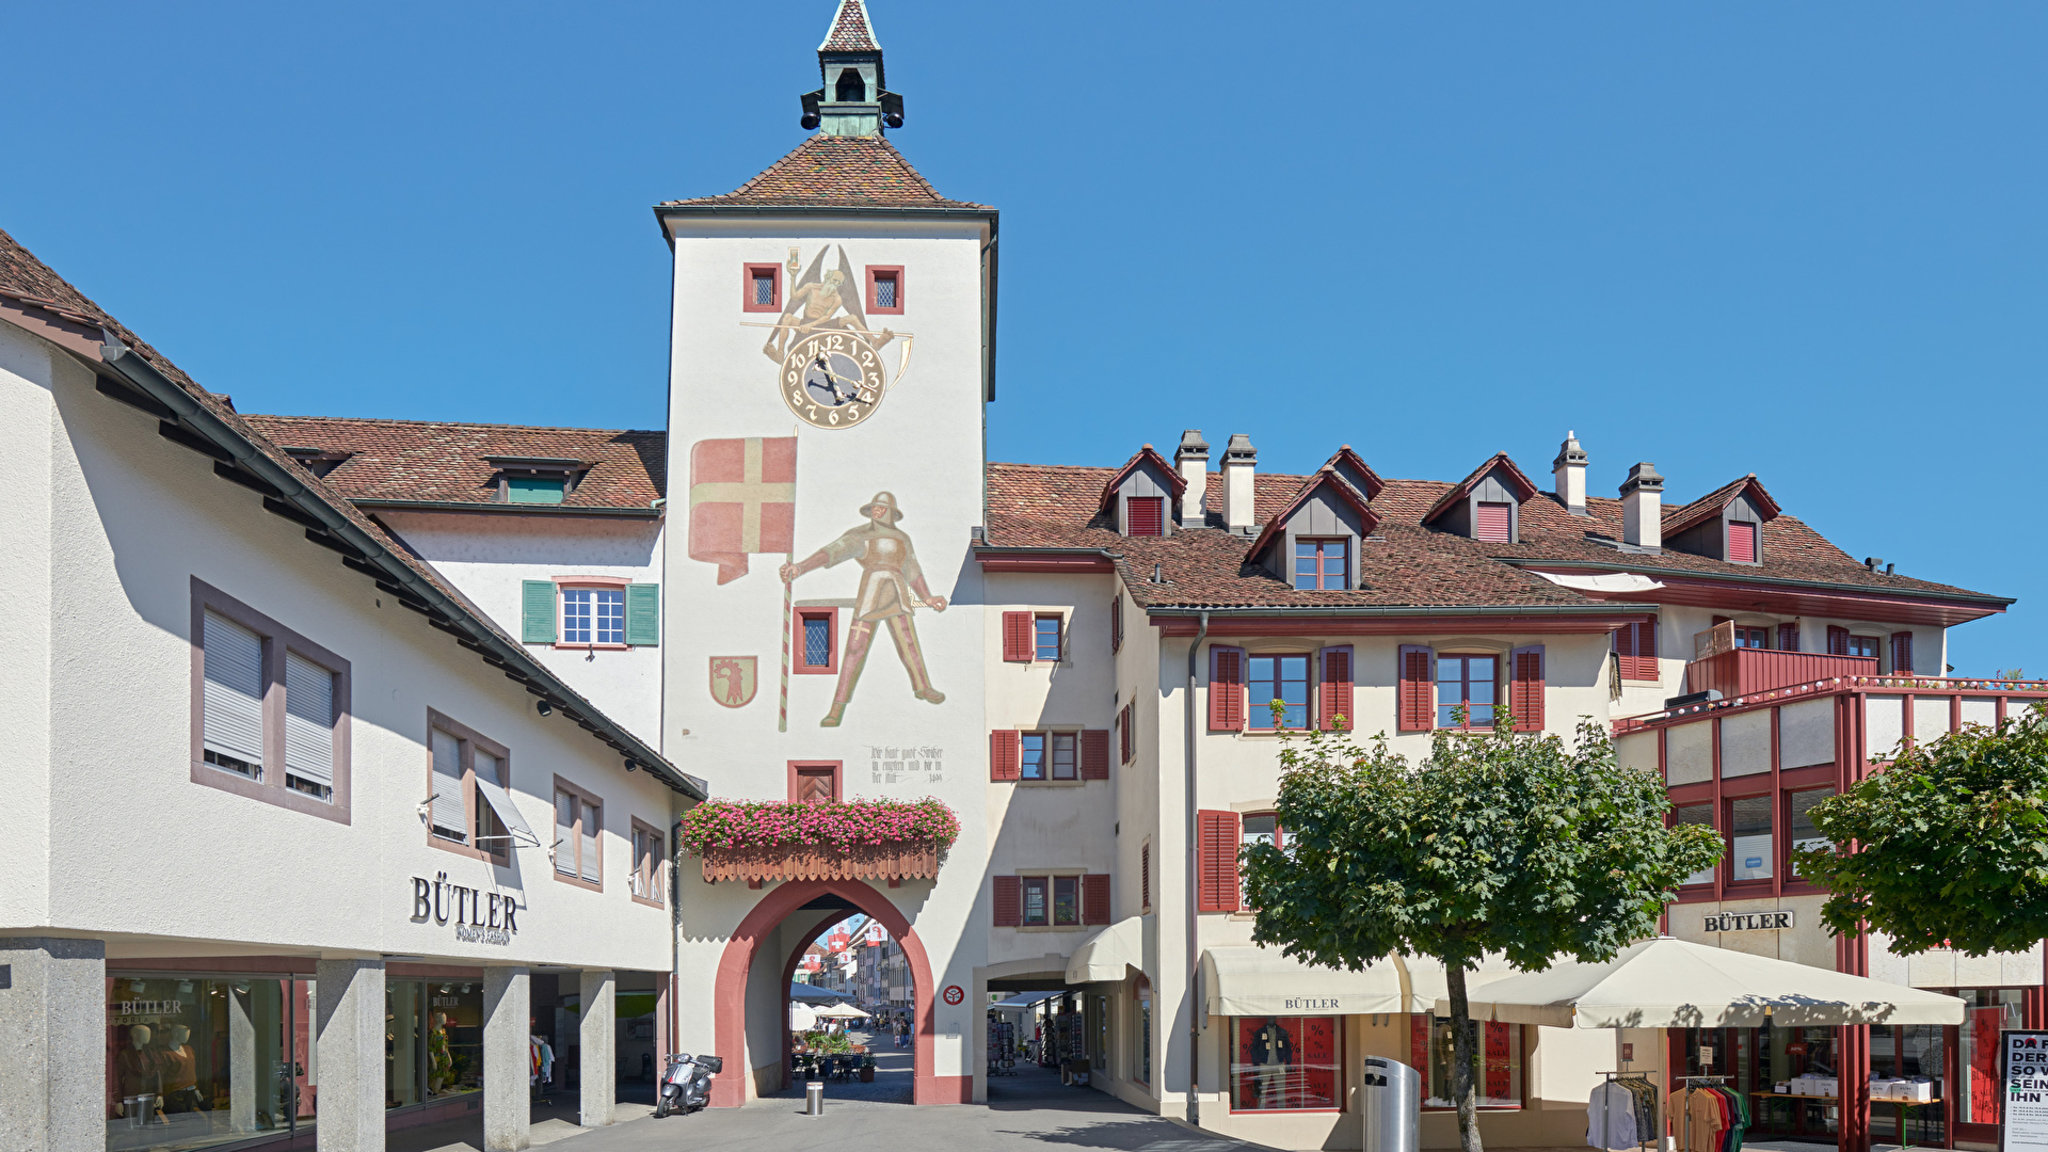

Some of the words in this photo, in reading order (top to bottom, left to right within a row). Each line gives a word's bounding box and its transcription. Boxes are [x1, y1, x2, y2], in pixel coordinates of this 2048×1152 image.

[808, 339, 819, 357] 11
[825, 335, 844, 350] 12
[850, 340, 857, 356] 1
[790, 353, 806, 368] 10
[861, 351, 875, 367] 2
[787, 370, 798, 387] 9
[868, 372, 880, 388] 3
[793, 389, 803, 406] 8
[861, 391, 874, 407] 4
[805, 405, 817, 420] 7
[829, 409, 839, 425] 6
[848, 404, 859, 420] 5
[410, 870, 518, 931] BÜTLER
[1704, 913, 1790, 932] BÜTLER
[121, 997, 182, 1015] BÜTLER
[1285, 997, 1340, 1009] BÜTLER
[2012, 1039, 2037, 1049] DA
[2012, 1052, 2048, 1062] DER
[2011, 1066, 2036, 1075] SO
[2011, 1079, 2048, 1089] SEIN
[2010, 1093, 2041, 1102] IHN
